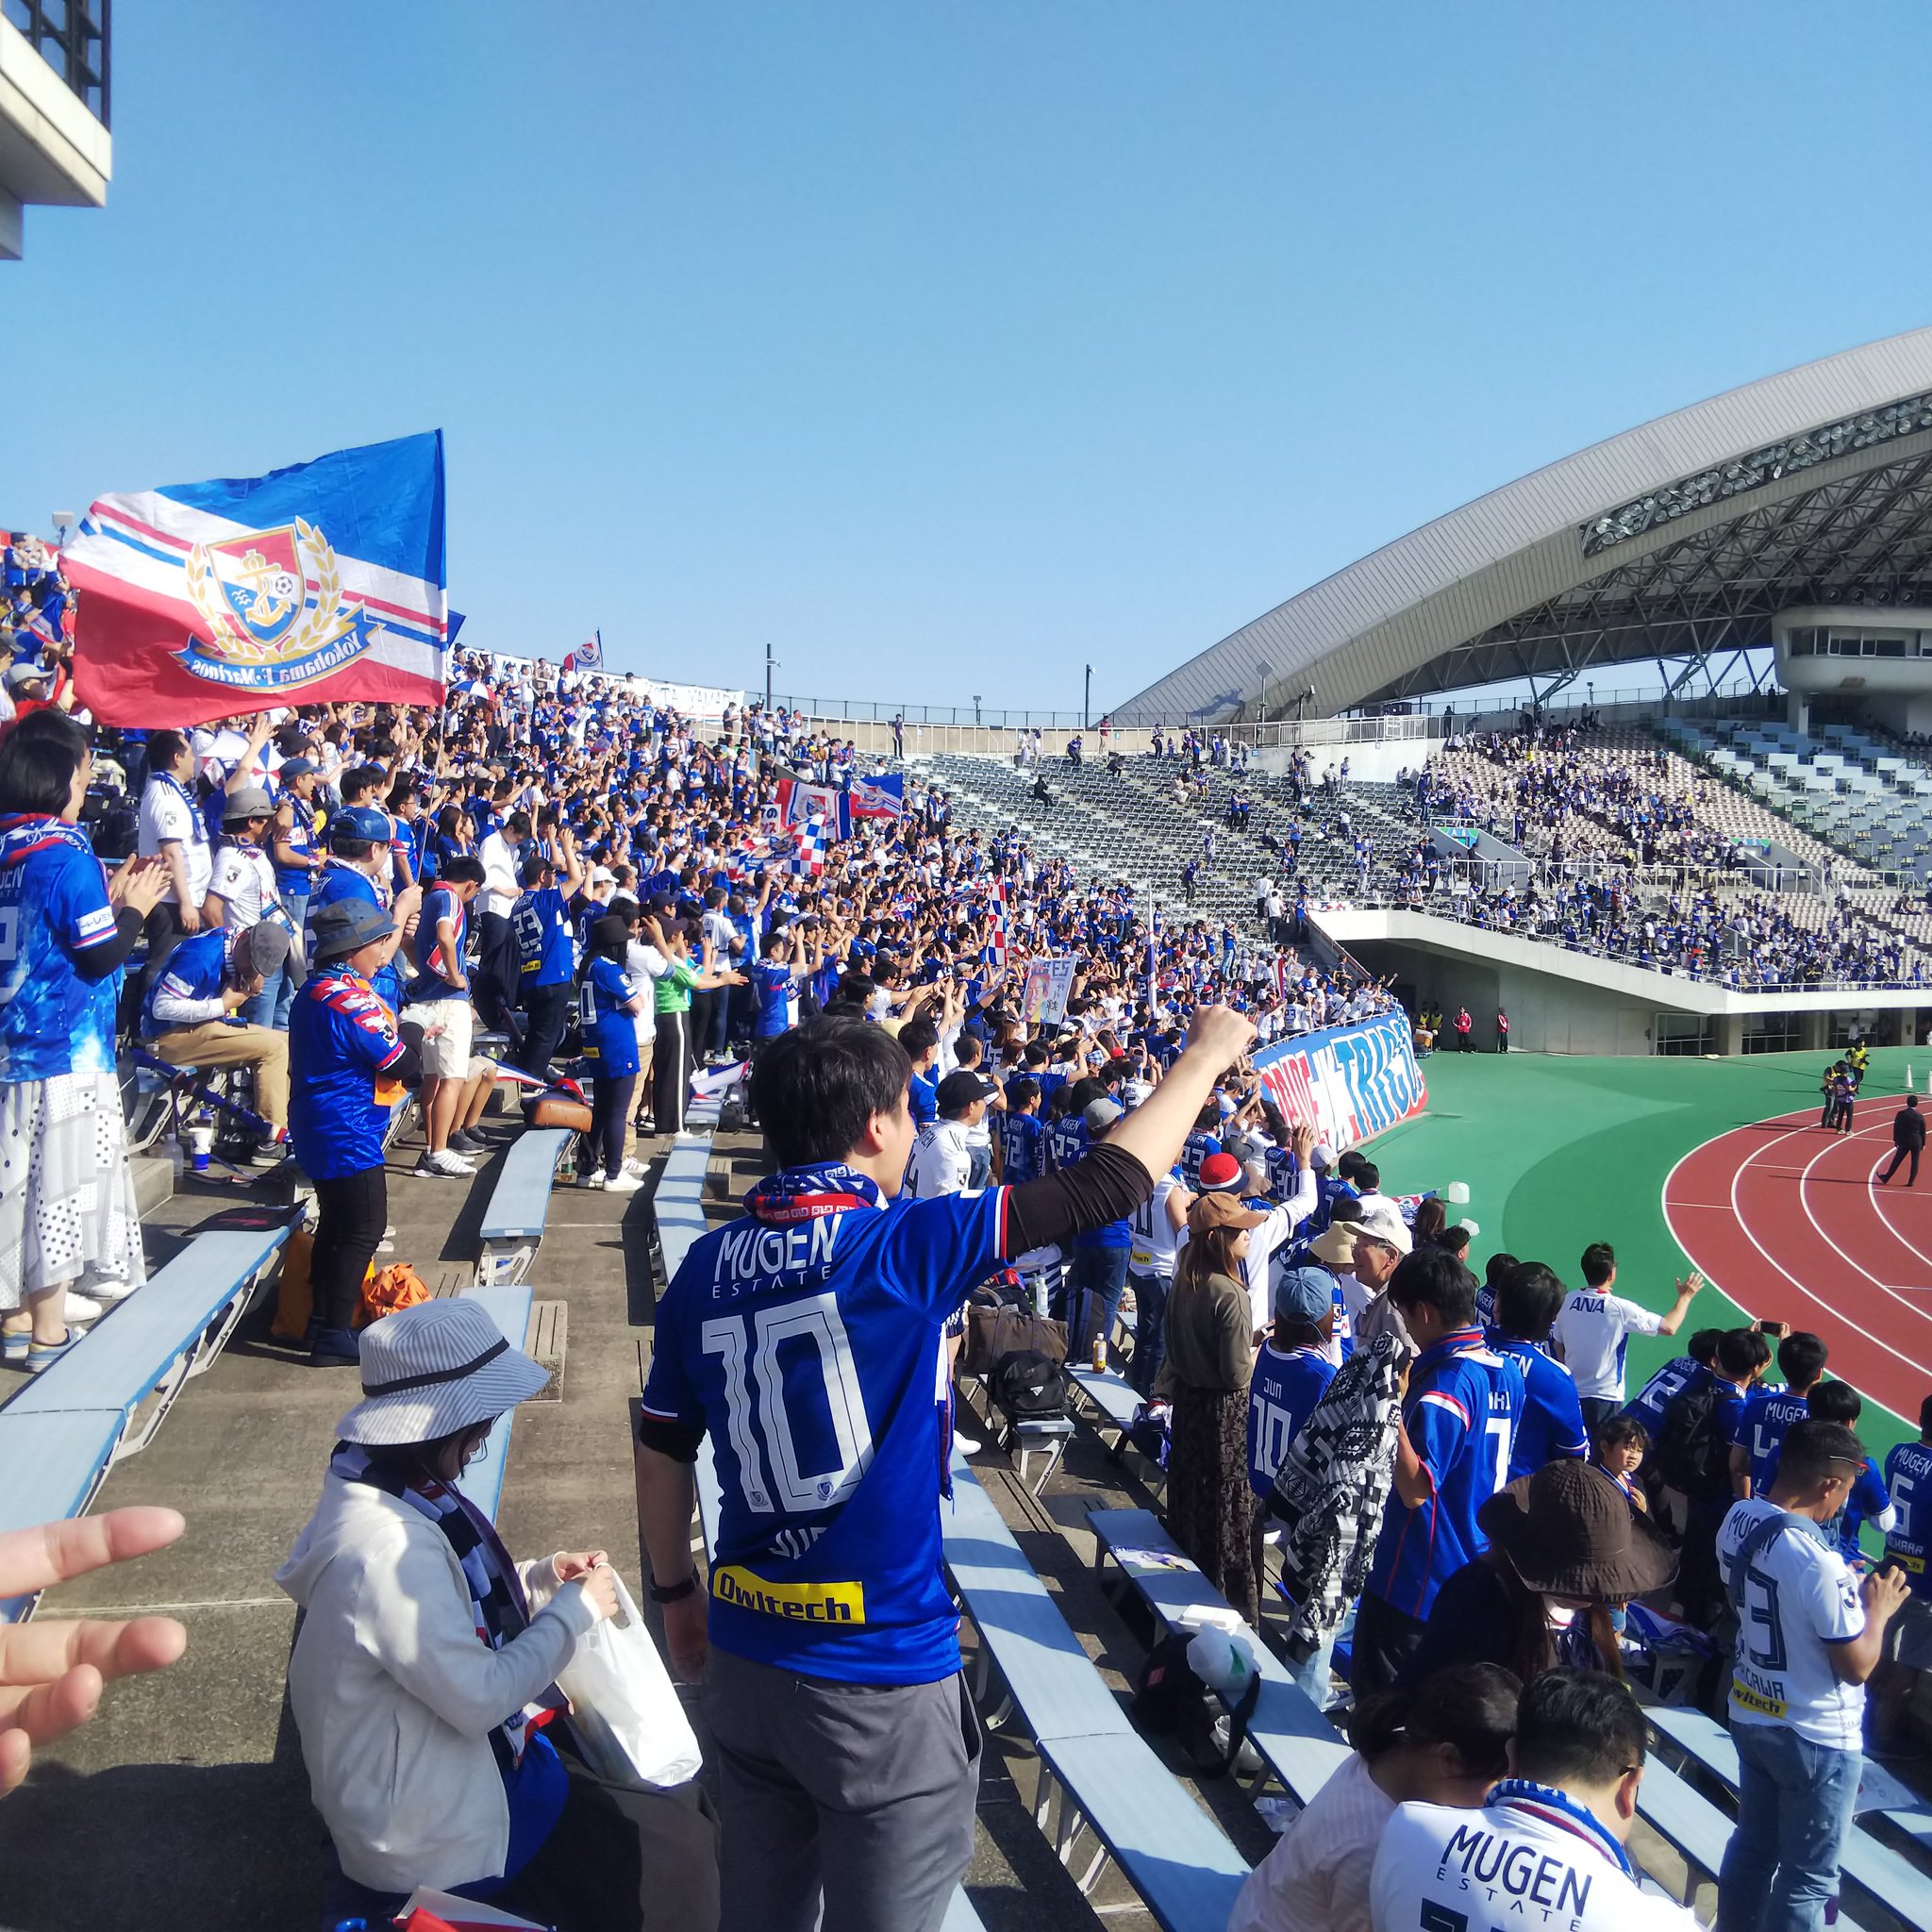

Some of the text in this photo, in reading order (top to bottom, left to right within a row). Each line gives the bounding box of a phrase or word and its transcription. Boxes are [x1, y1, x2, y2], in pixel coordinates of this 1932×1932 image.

[1058, 1117, 1082, 1134] MUGEN
[714, 1213, 843, 1283] MUGEN
[712, 1264, 831, 1299] ESTATE
[1569, 1297, 1605, 1314] ANA
[702, 1291, 875, 1513] 10
[1252, 1392, 1292, 1480] 10
[1895, 1446, 1932, 1477] MUGEN
[719, 1573, 852, 1621] Owltech
[1441, 1824, 1593, 1918] MUGEN
[1436, 1867, 1582, 1932] ESTATE
